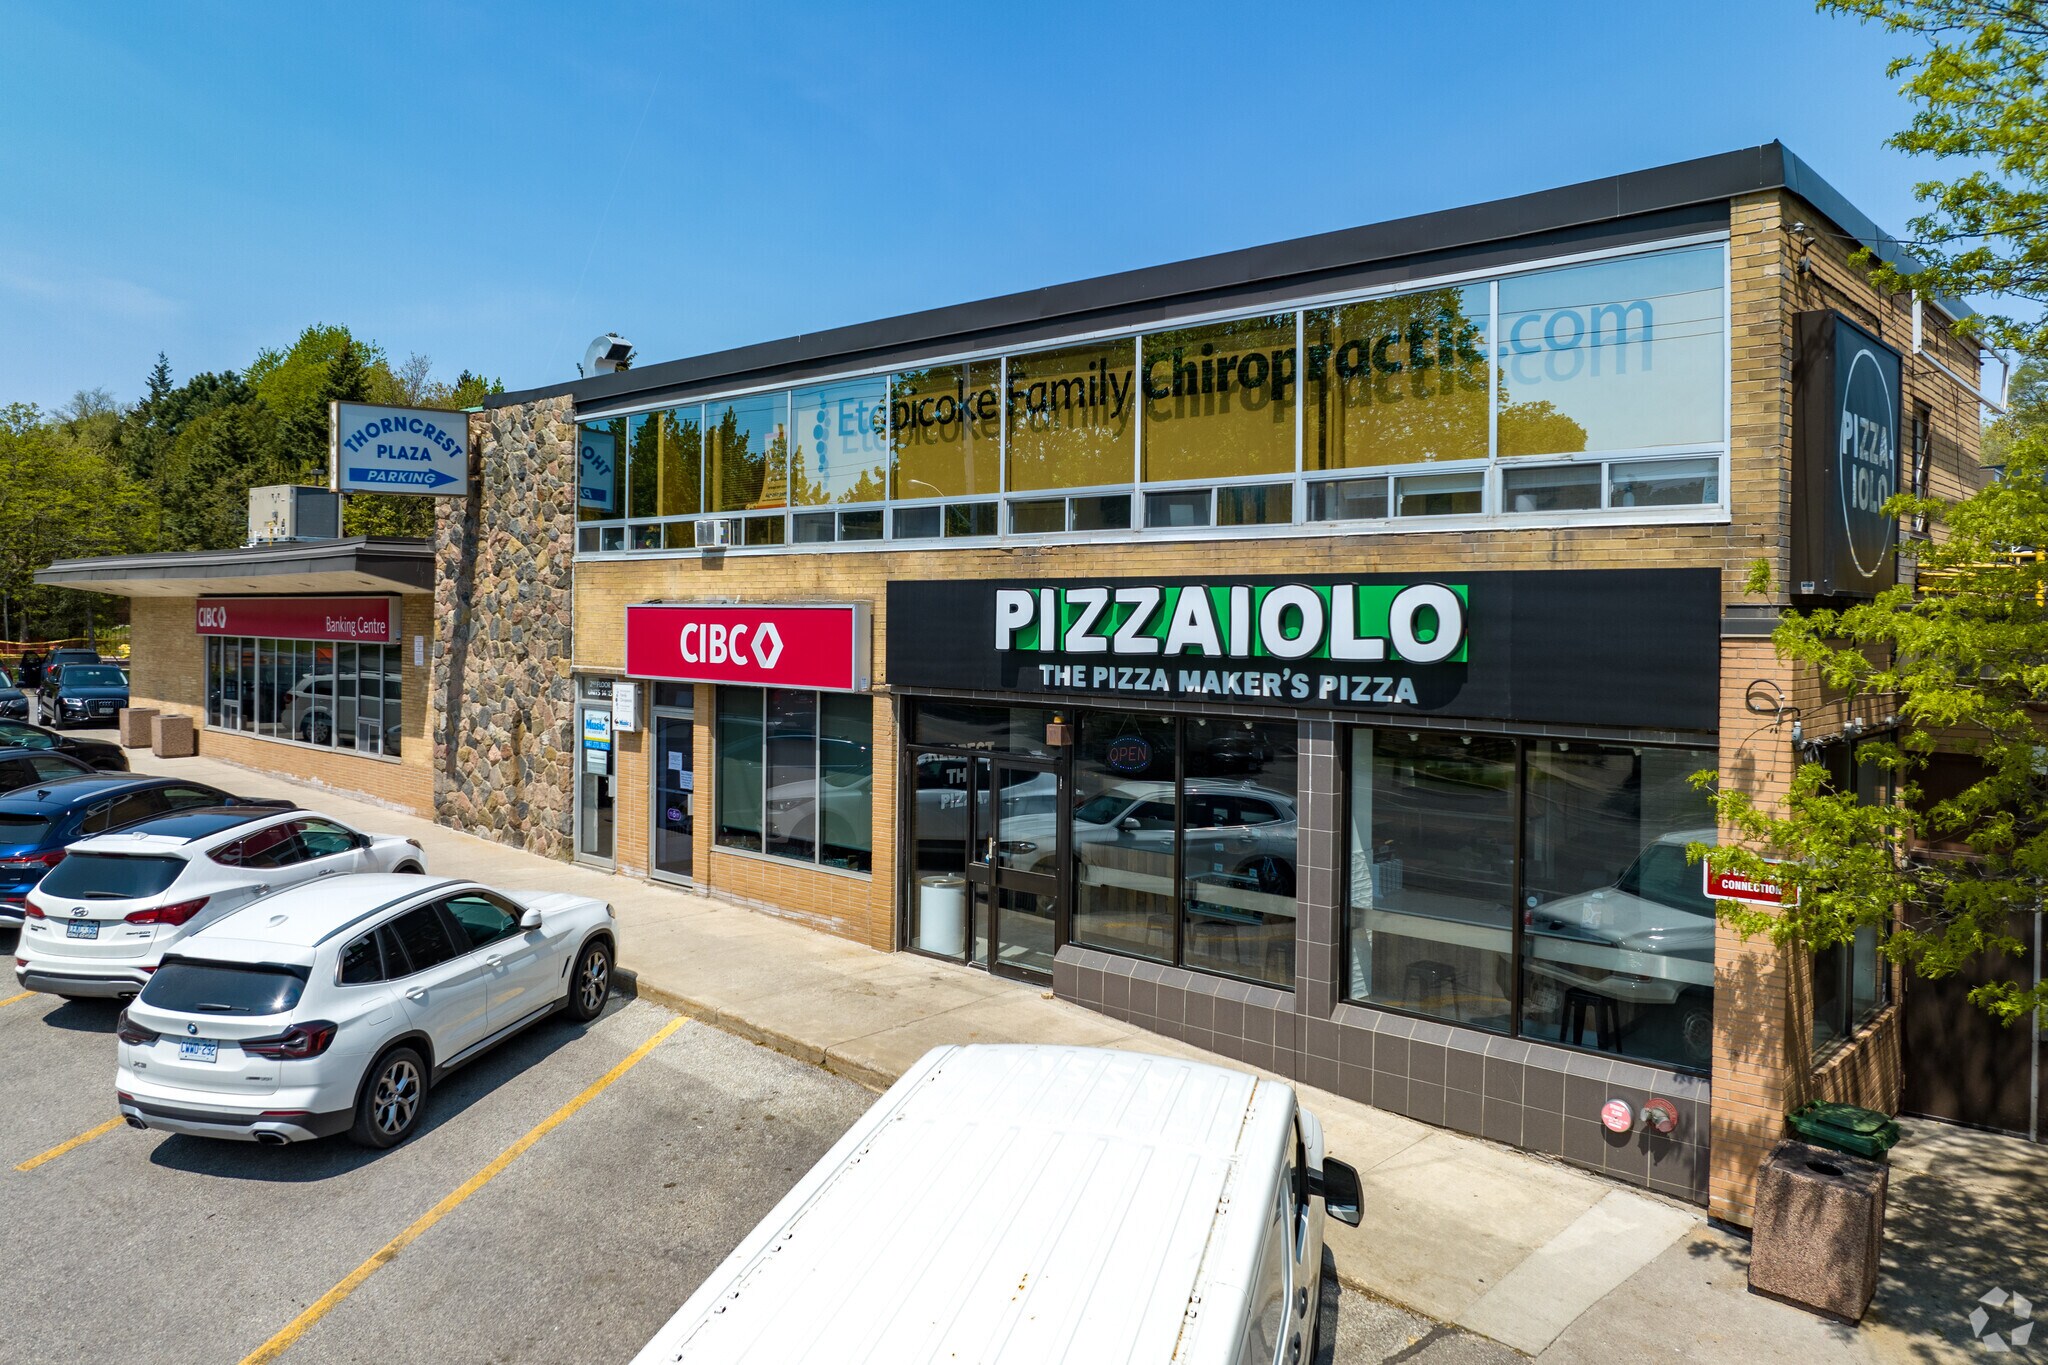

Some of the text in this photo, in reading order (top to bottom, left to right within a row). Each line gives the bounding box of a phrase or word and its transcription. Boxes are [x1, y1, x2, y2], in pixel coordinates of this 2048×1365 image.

[1008, 358, 1133, 418] Family
[343, 416, 463, 458] THORNCREST
[377, 444, 432, 461] PLAZA
[367, 470, 437, 484] PARKING
[1852, 464, 1888, 513] IOLO
[198, 607, 218, 628] CIBC
[326, 616, 386, 637] Banking Centre
[995, 583, 1463, 663] PIZZAIOLO
[680, 622, 749, 666] CIBC
[1039, 664, 1419, 705] THE PIZZA MAKER'S PIZZA
[586, 719, 606, 731] Music
[1110, 746, 1147, 761] OPEN
[946, 767, 968, 784] TH
